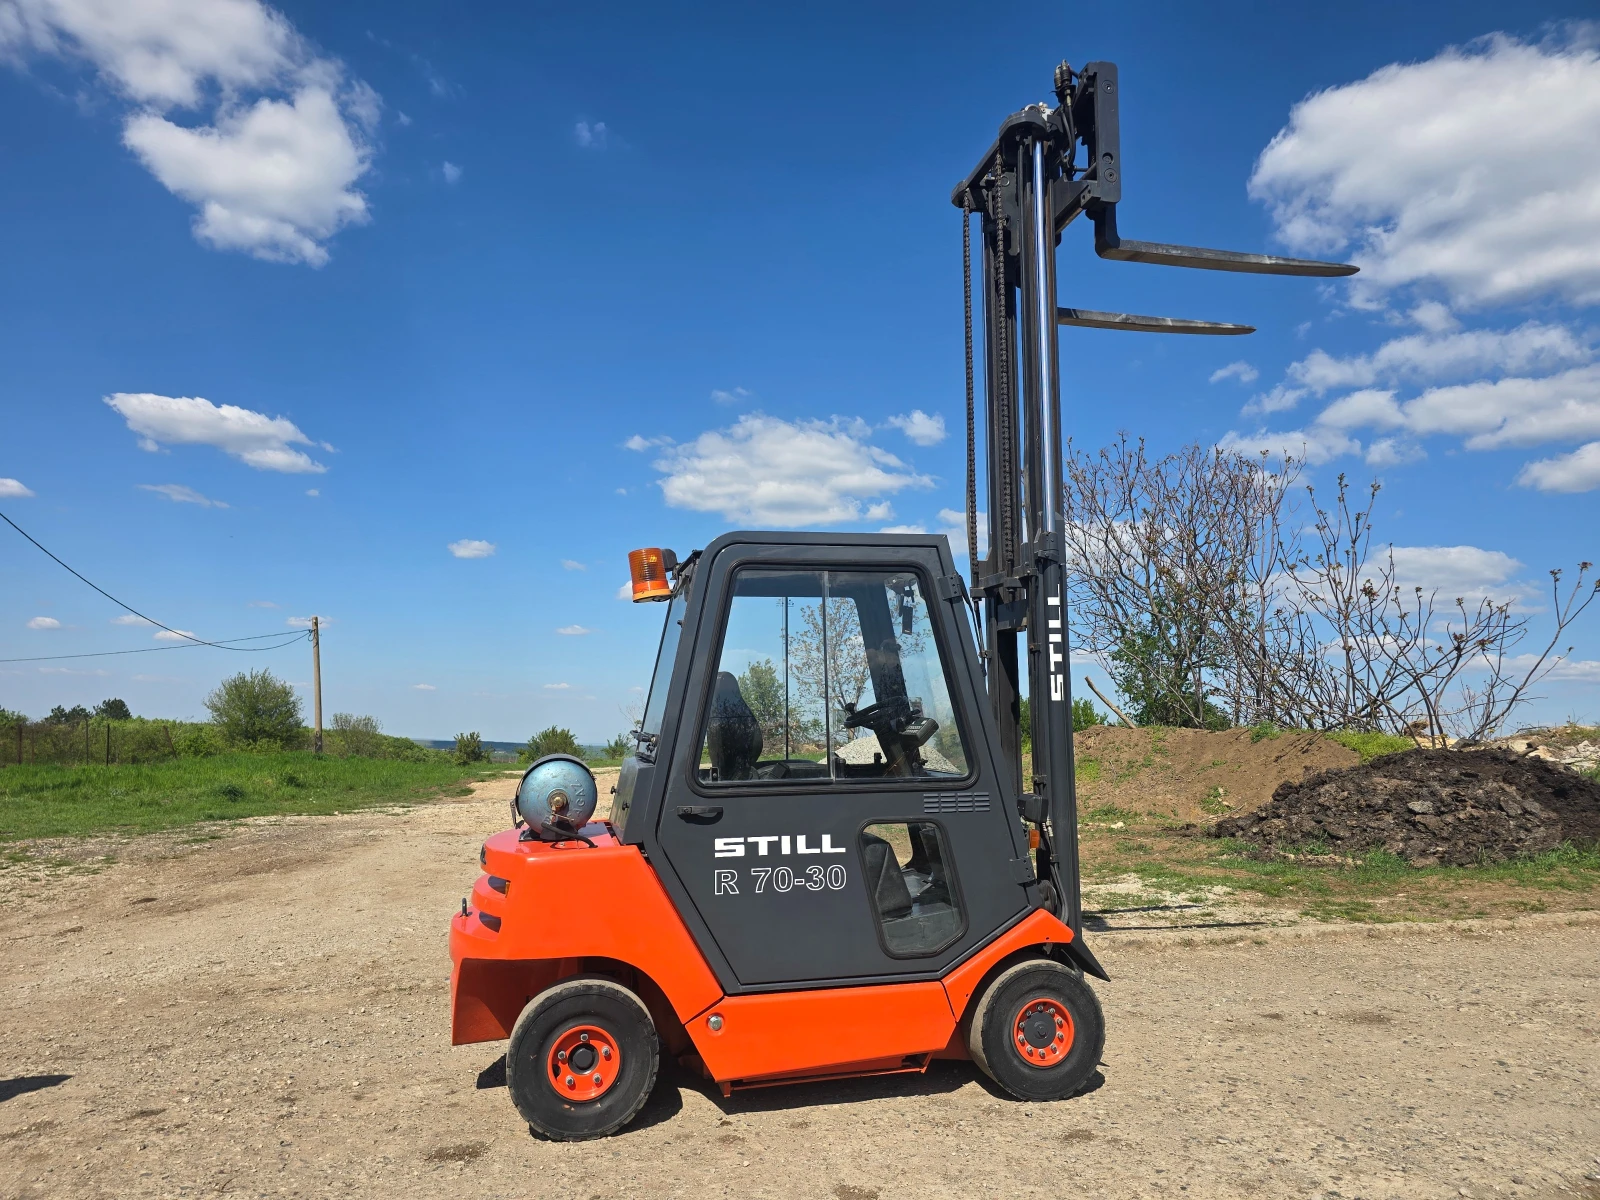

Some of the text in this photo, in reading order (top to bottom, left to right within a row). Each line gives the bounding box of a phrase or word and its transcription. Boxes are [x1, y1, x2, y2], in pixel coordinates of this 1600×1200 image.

[1047, 583, 1064, 701] STILL
[714, 834, 847, 858] STILL
[714, 864, 847, 895] R 70-30
